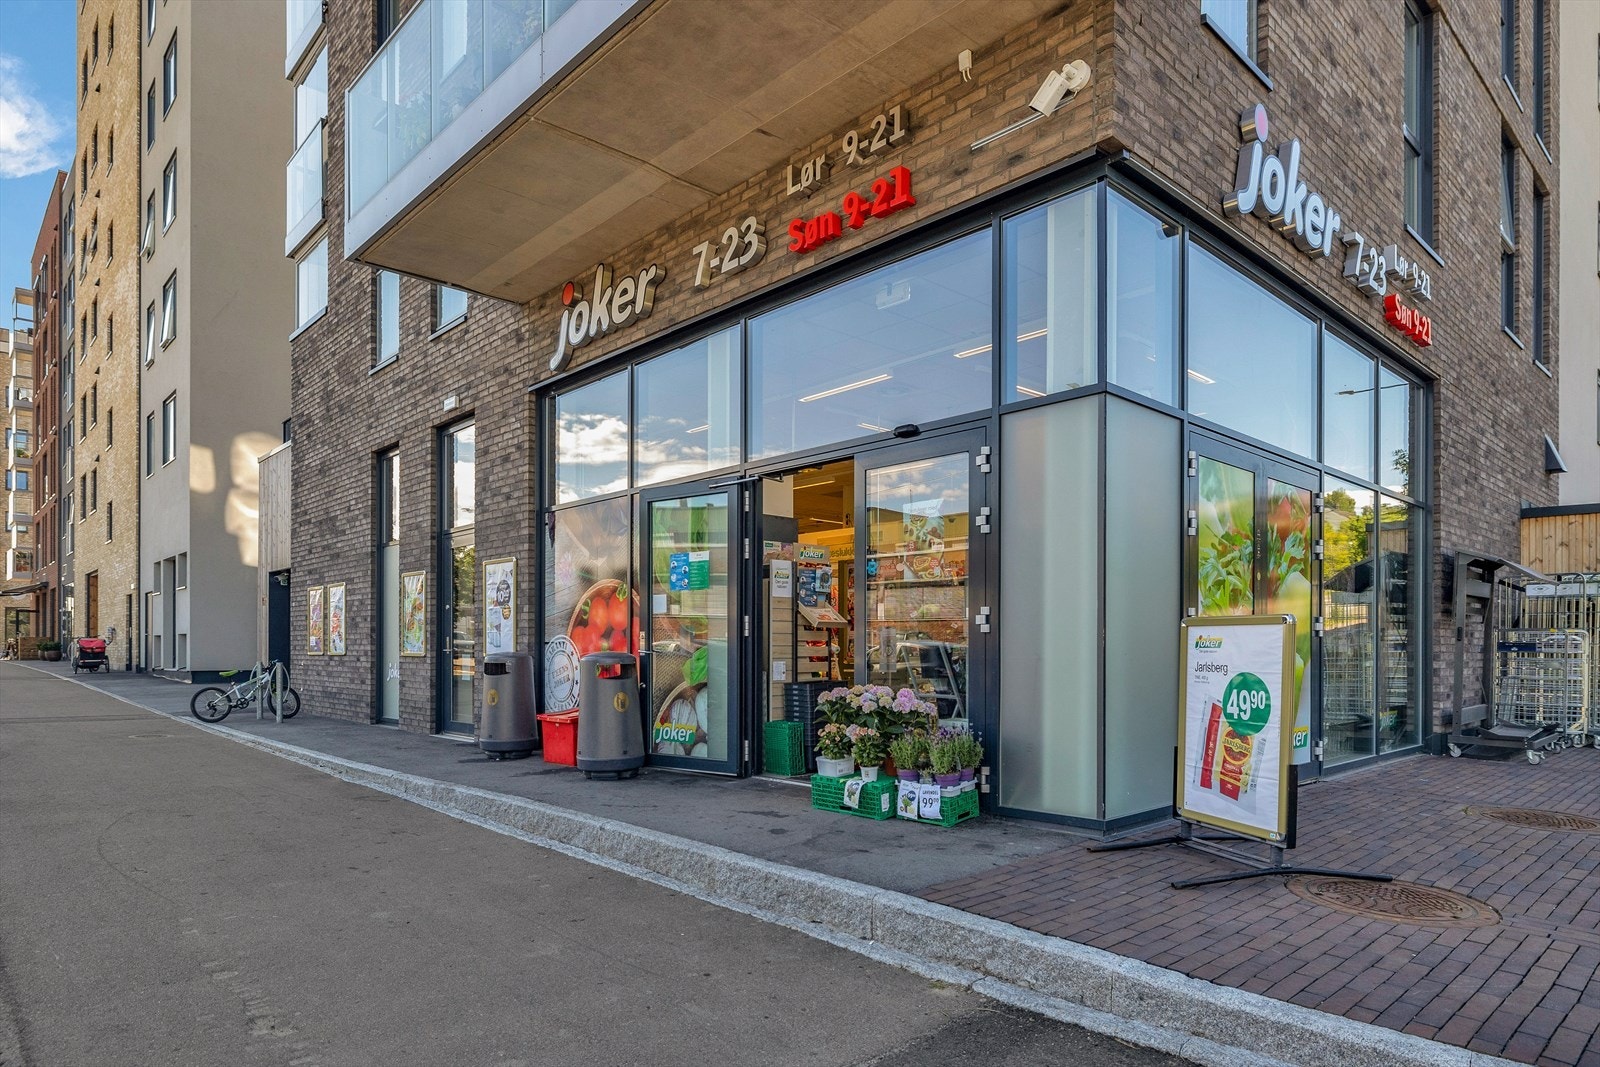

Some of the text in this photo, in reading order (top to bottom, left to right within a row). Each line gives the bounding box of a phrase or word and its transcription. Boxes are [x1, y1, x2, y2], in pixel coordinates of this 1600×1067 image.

[787, 104, 907, 197] Lør 9-21
[1227, 103, 1341, 257] joker
[787, 164, 916, 254] Søn 9-21
[692, 215, 766, 289] 7-23
[1344, 232, 1387, 297] 7-23
[1390, 243, 1432, 301] Lør 9-21
[549, 262, 665, 373] joker
[1391, 293, 1433, 346] Søn 9-21
[801, 545, 823, 558] joker
[1194, 662, 1228, 676] Jarlsberg
[1195, 635, 1221, 650] joker
[656, 718, 693, 743] joker
